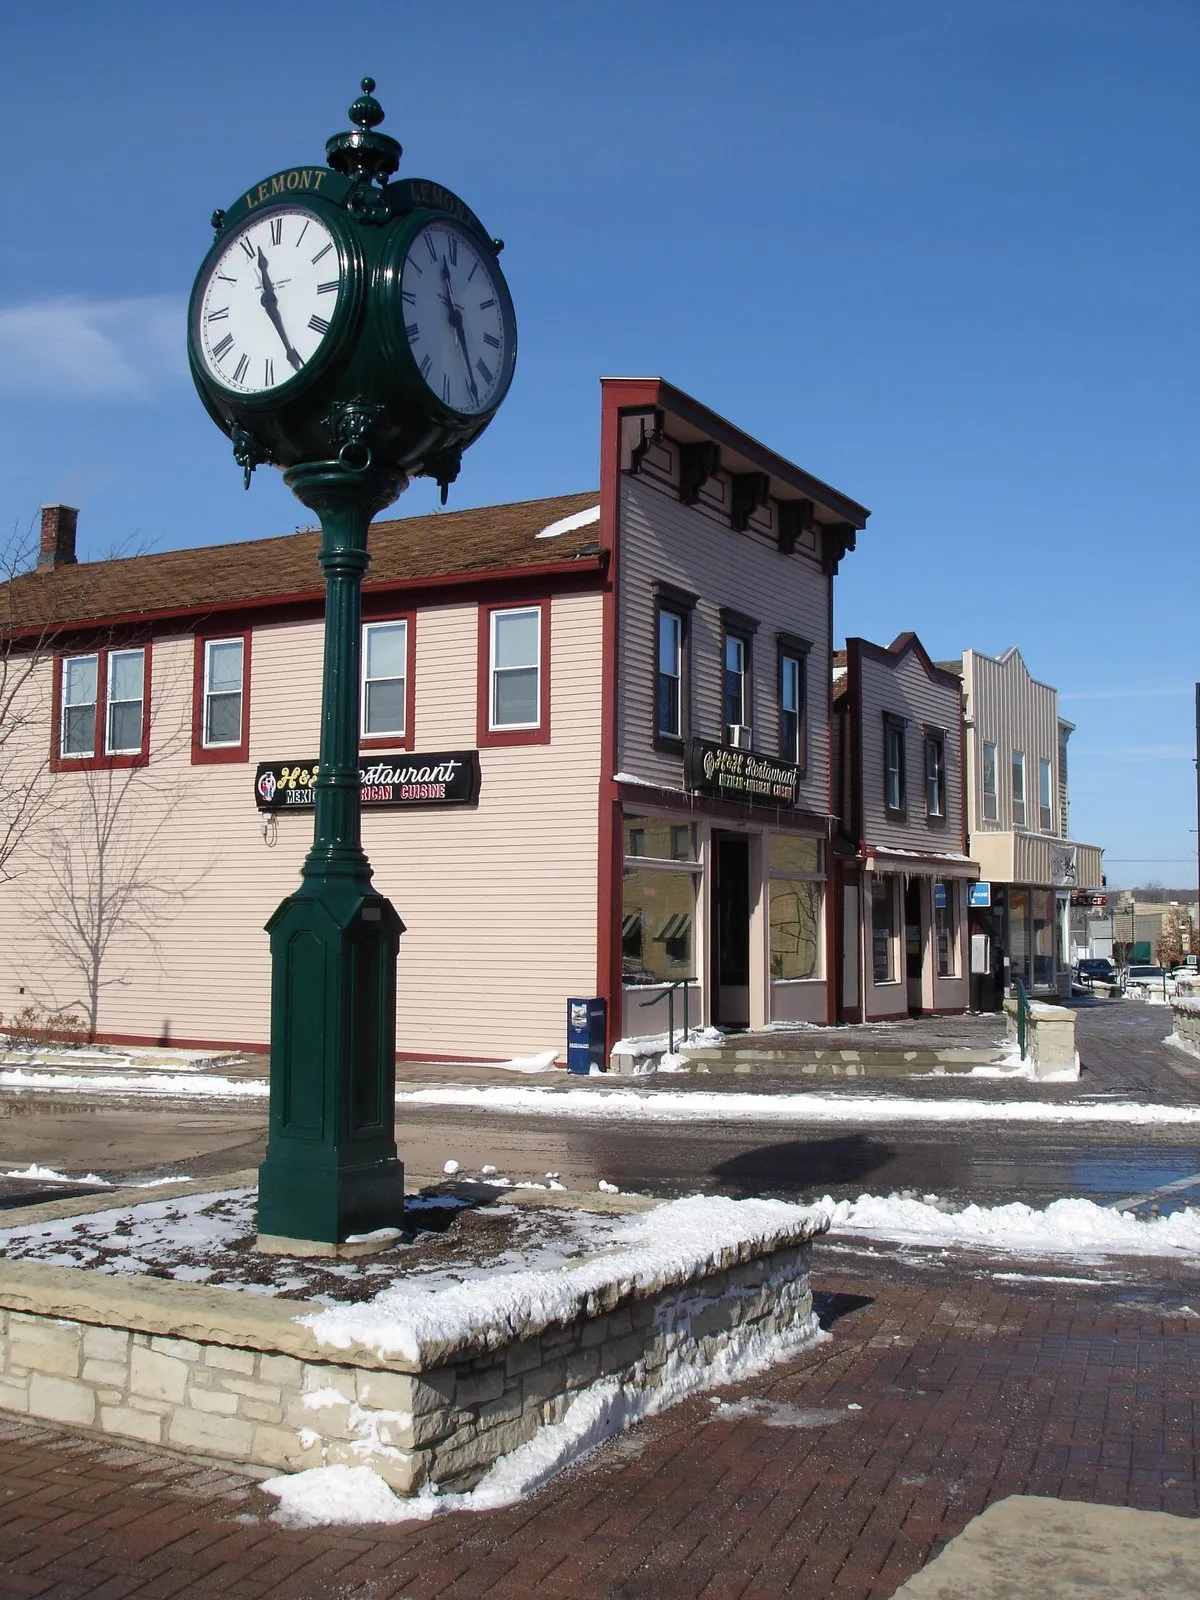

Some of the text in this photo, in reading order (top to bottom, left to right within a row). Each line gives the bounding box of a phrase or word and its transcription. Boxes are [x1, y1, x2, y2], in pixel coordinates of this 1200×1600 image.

[245, 170, 327, 209] LEMONT
[410, 182, 472, 227] LEMONT
[269, 217, 283, 247] XII
[240, 236, 256, 262] XI
[311, 243, 333, 265] II
[218, 271, 237, 287] X
[317, 280, 340, 295] III
[208, 307, 229, 322] IX
[359, 759, 462, 785] estaurant
[746, 757, 799, 785] Restaurant
[286, 784, 445, 804] MEXI RICAN CUISINE
[746, 779, 770, 795] AMERICAN
